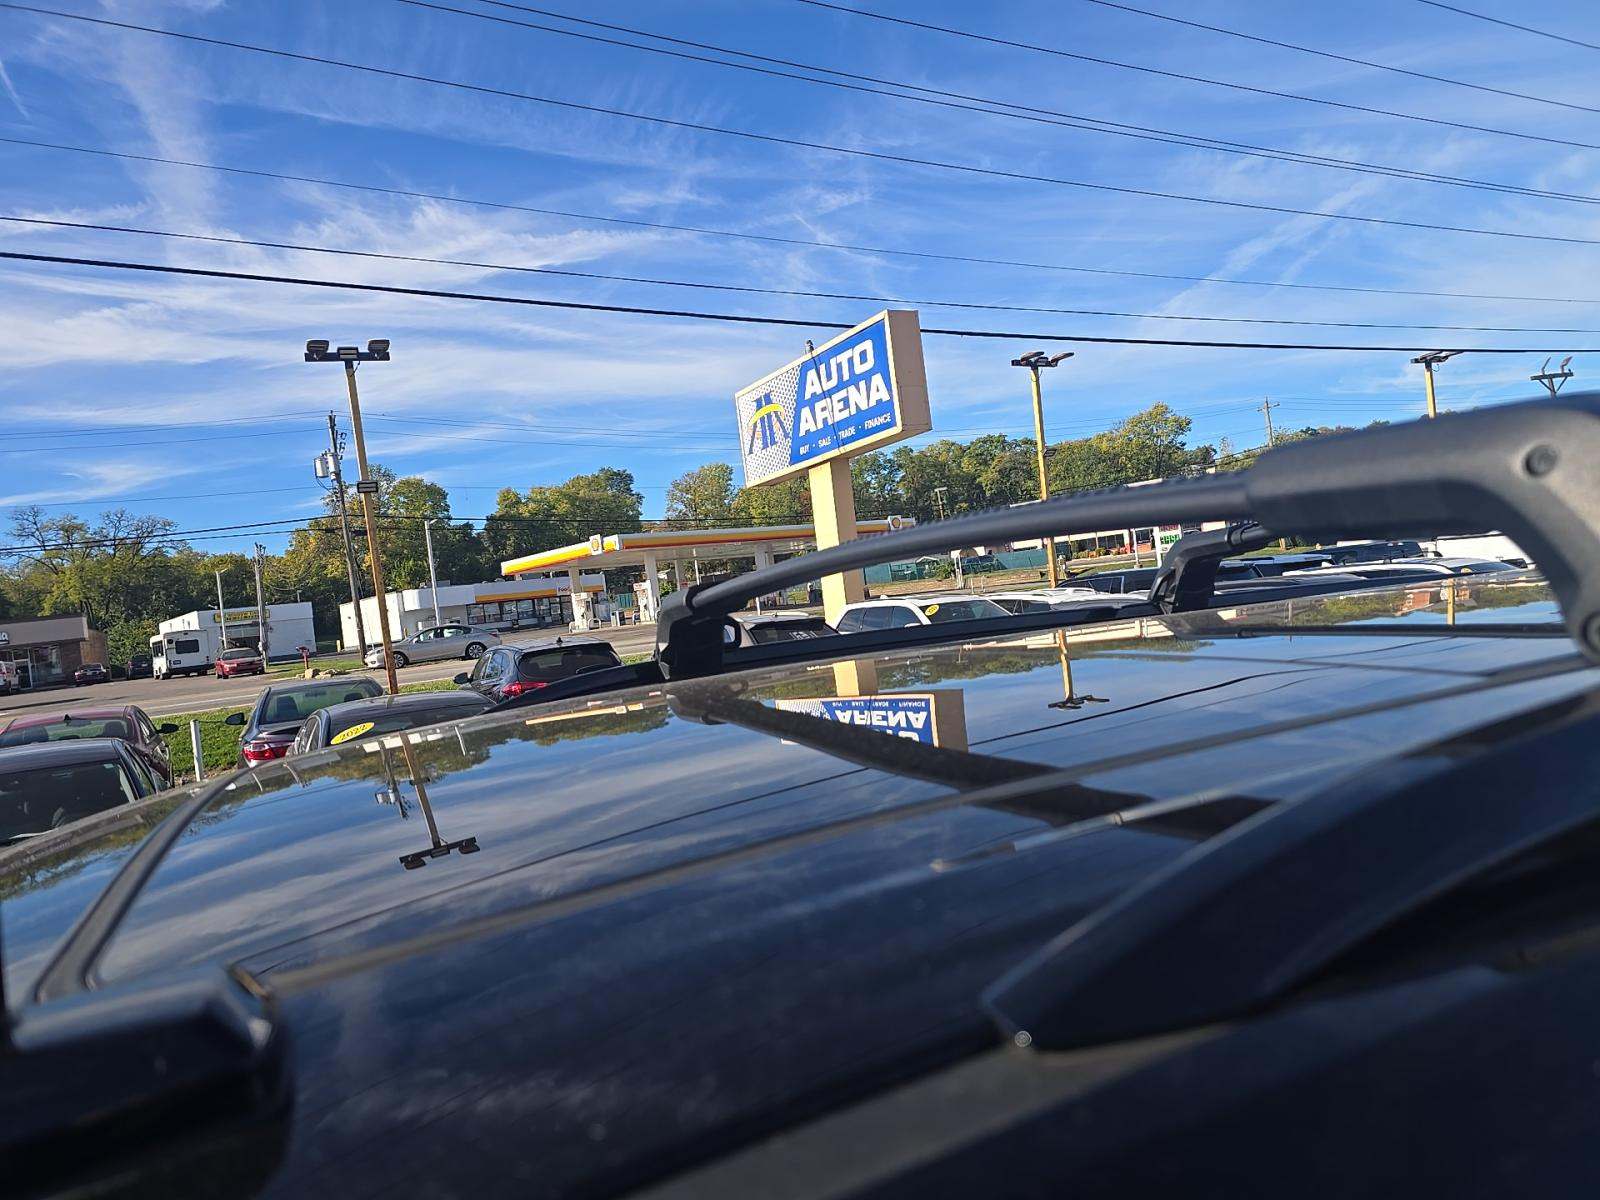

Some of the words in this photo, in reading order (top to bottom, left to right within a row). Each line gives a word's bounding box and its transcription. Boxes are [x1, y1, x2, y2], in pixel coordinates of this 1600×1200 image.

[804, 339, 875, 400] AUTO
[798, 372, 891, 437] ARENA
[799, 443, 810, 456] BUY
[838, 425, 856, 441] TRADE
[864, 412, 892, 430] FINANCE
